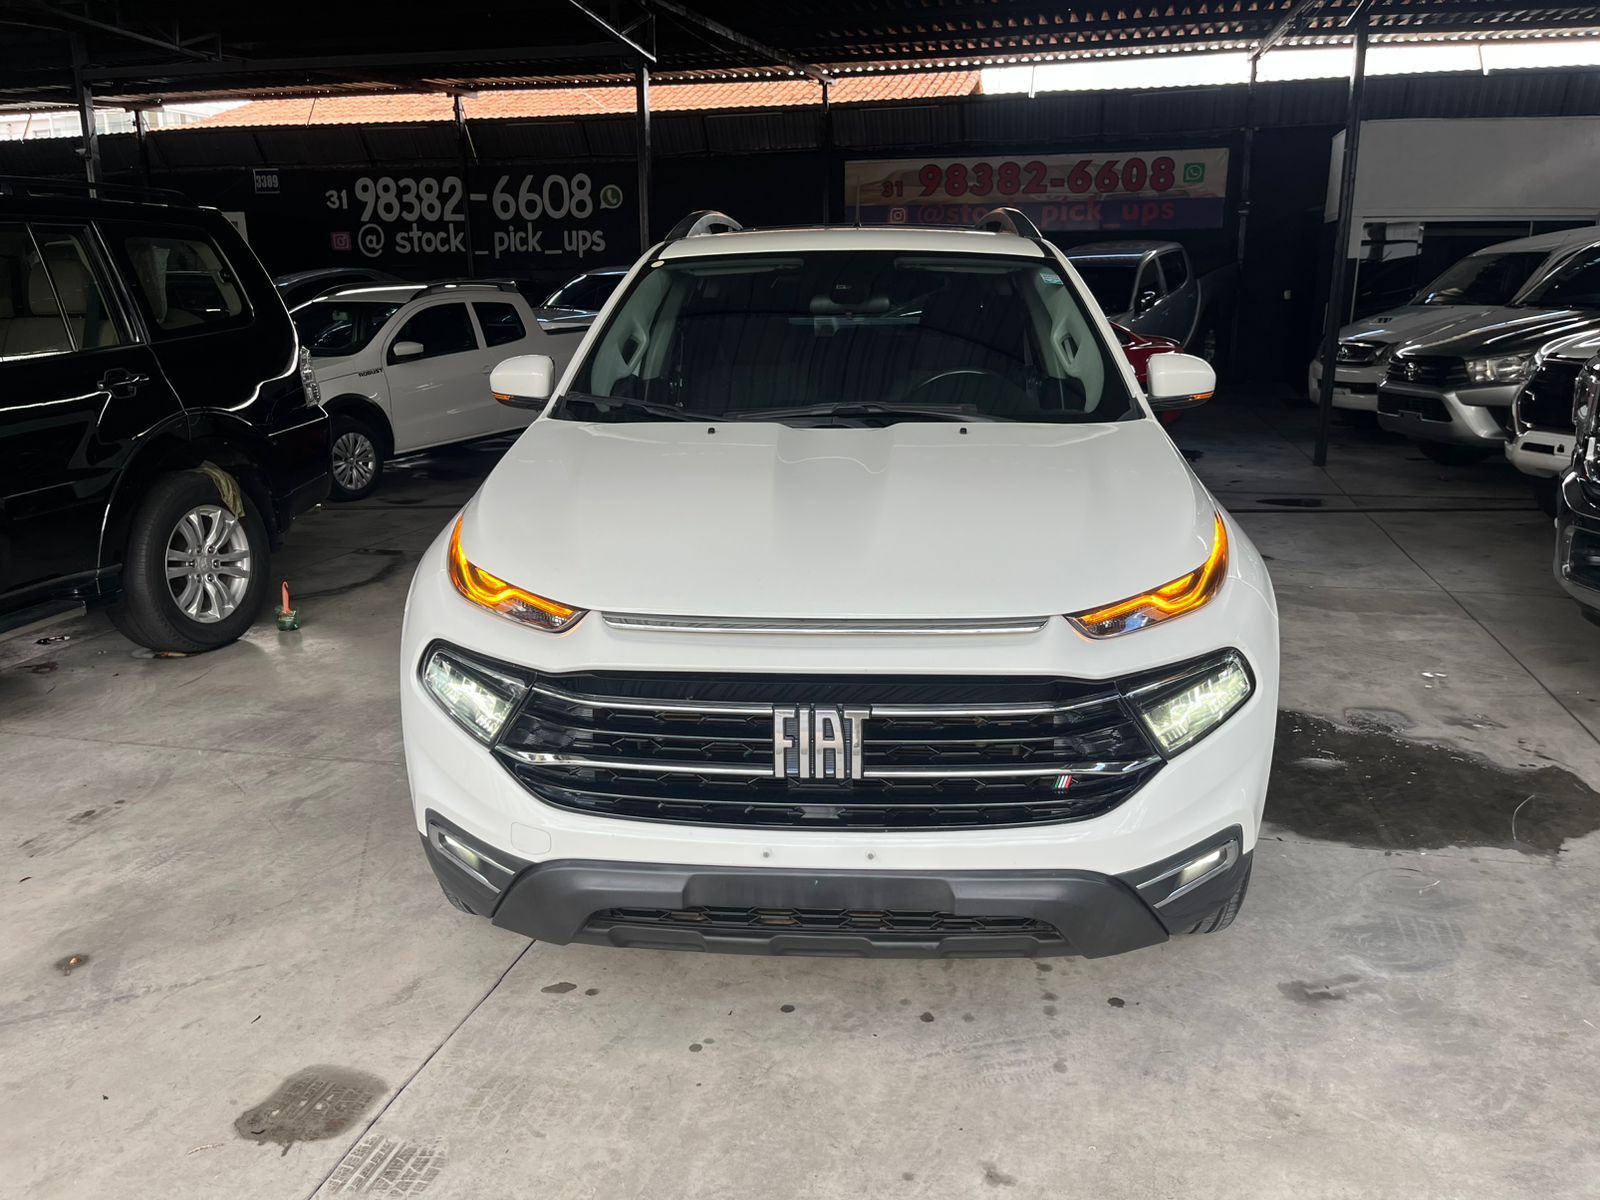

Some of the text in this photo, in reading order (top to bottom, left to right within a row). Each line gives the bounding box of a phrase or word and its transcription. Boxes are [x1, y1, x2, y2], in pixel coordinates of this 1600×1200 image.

[325, 173, 592, 222] 31 98382-6608
[880, 156, 1176, 198] 31 98382-6608
[774, 708, 870, 779] FIAT
